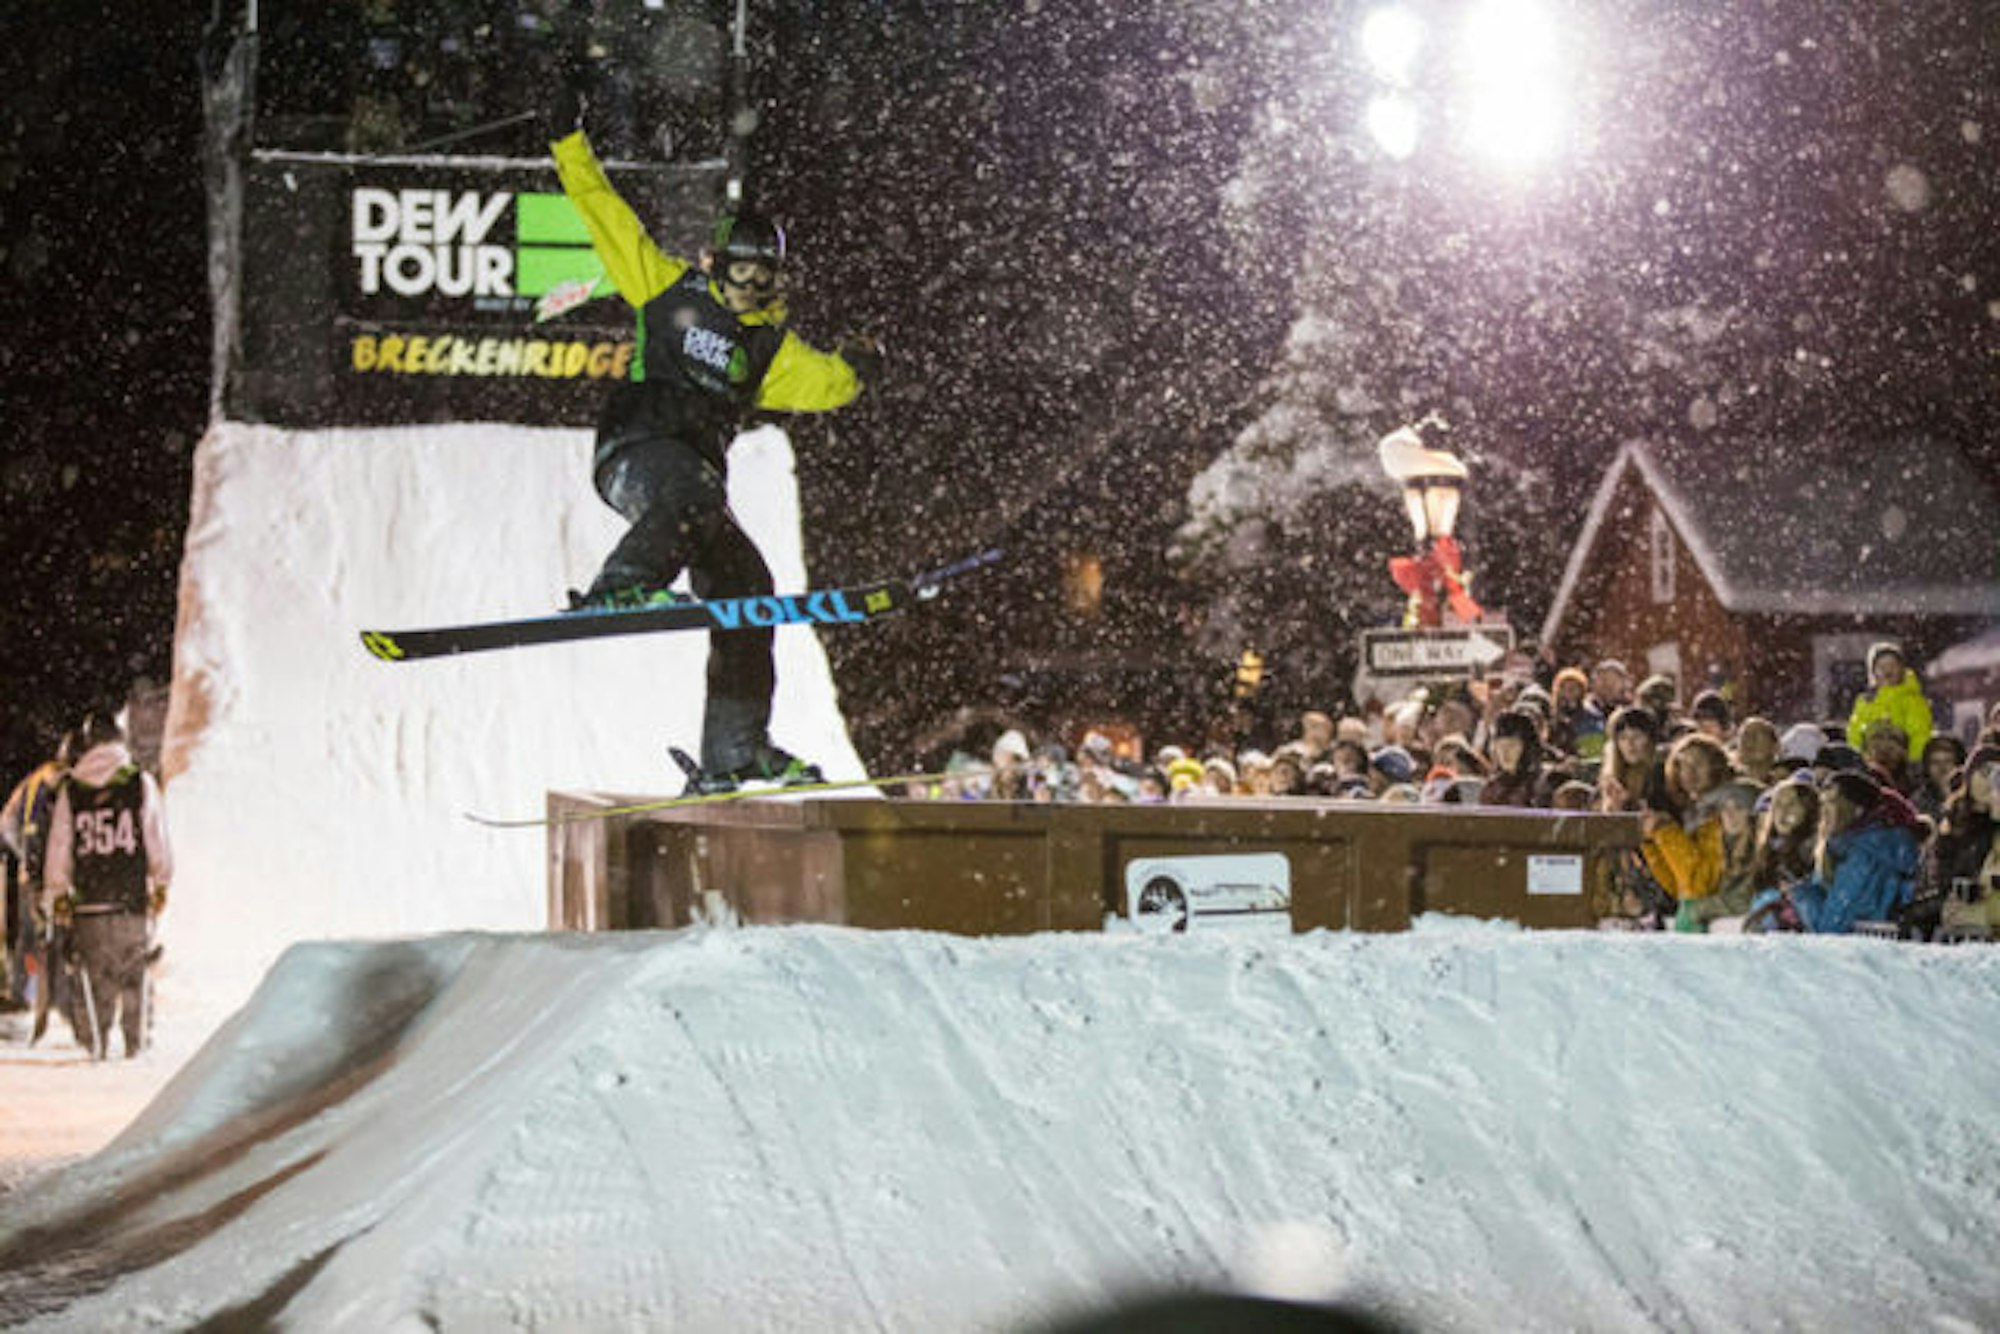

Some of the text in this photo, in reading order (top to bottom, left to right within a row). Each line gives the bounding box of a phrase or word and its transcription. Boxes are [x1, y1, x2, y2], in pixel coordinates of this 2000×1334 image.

[351, 187, 513, 245] DEW
[353, 243, 516, 296] TOUR
[352, 335, 634, 378] BRECKENRIDGE
[1378, 645, 1467, 662] ONE WAY
[76, 809, 137, 855] 354
